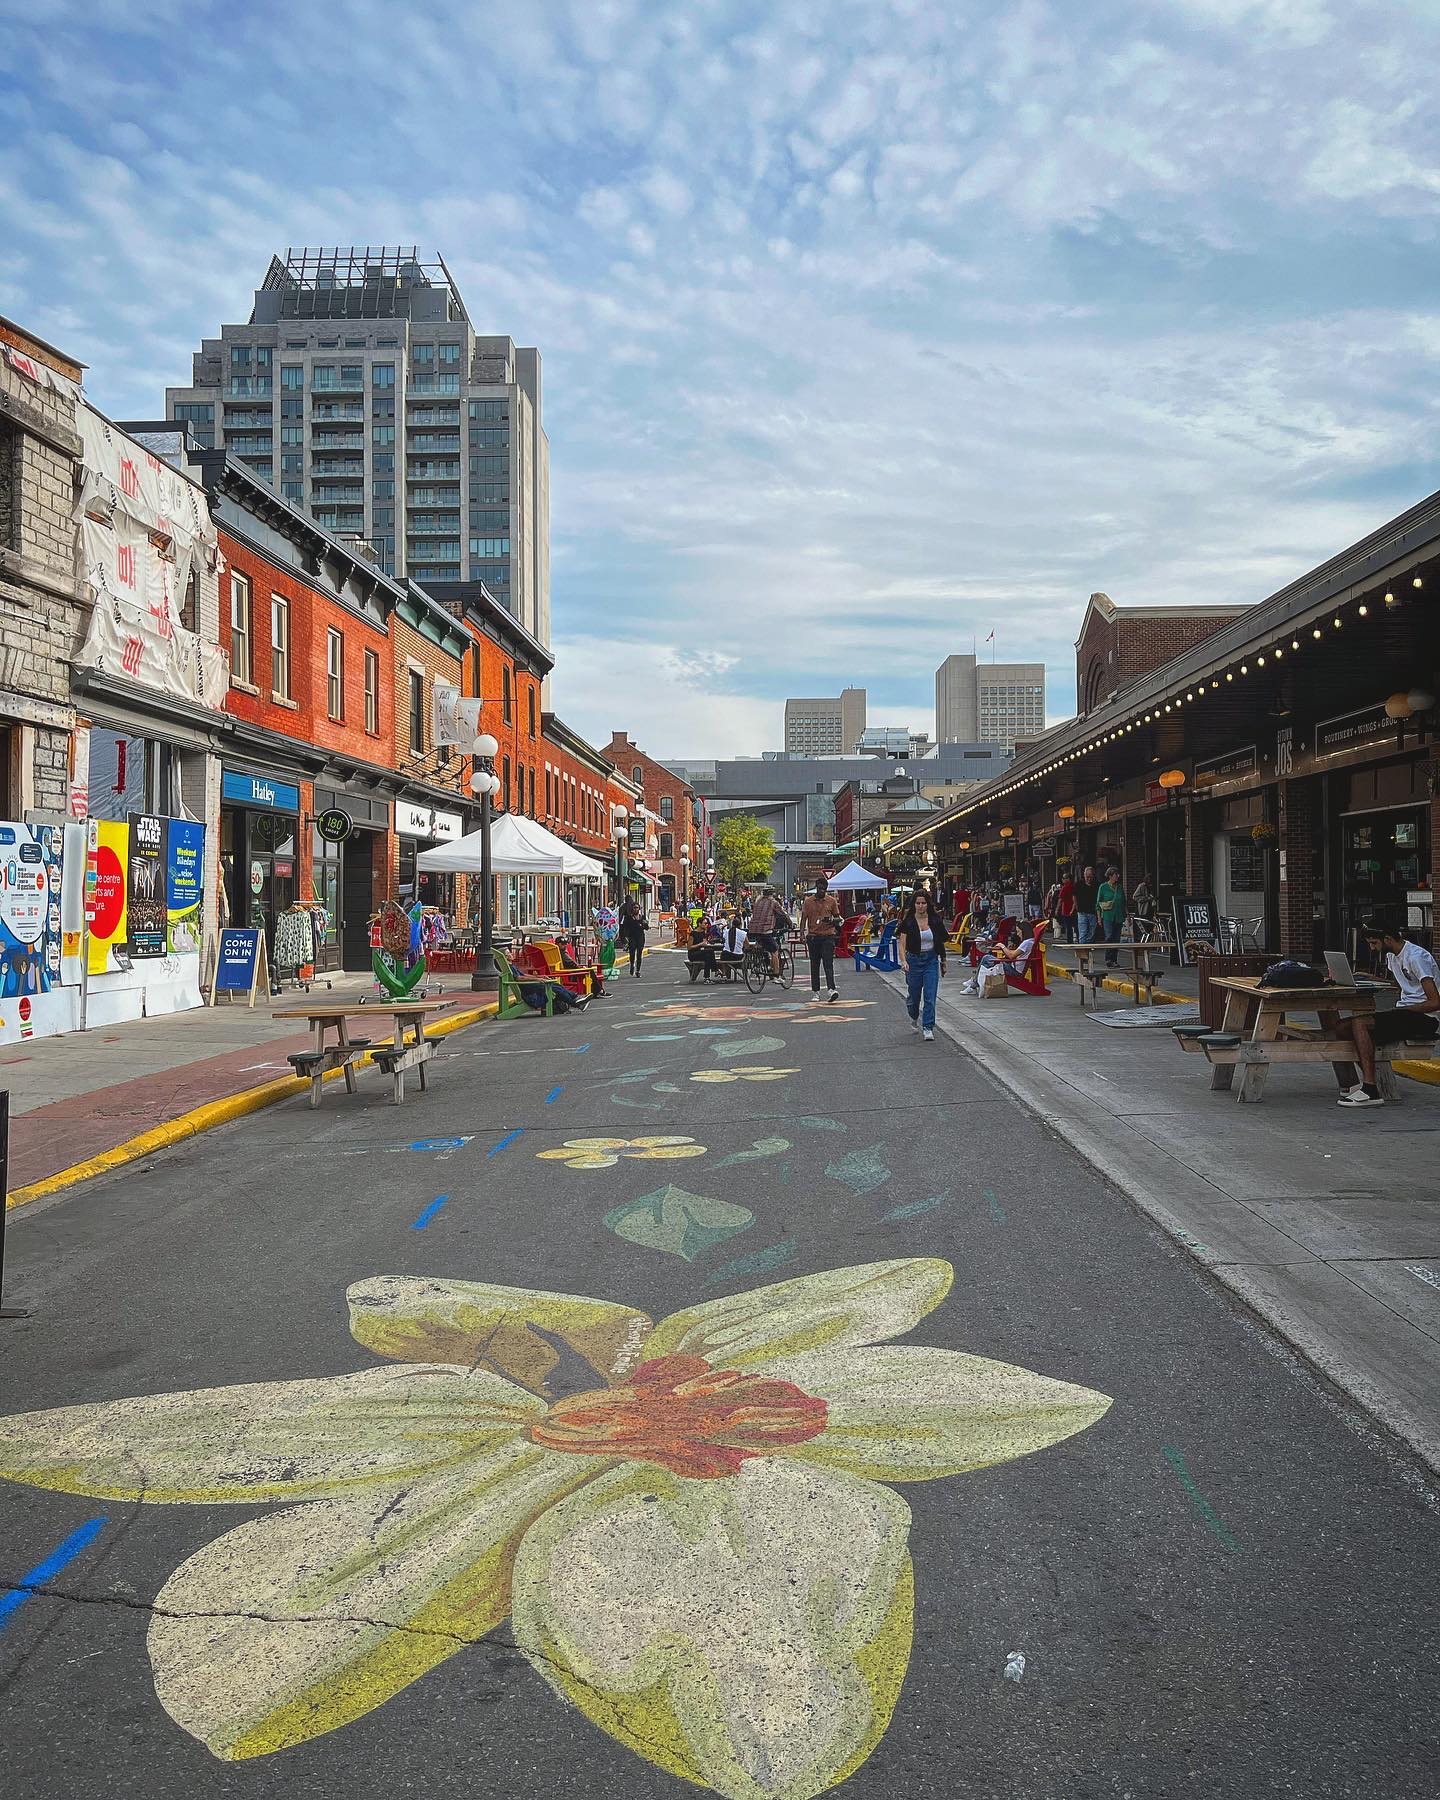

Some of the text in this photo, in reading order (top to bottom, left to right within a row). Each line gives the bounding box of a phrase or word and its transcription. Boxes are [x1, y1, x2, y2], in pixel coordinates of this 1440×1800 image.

[1275, 741, 1293, 776] JOS
[251, 780, 275, 806] Hatley
[137, 817, 161, 831] STAR
[137, 828, 161, 843] WARS
[103, 874, 120, 884] centre
[104, 887, 114, 896] and
[1188, 911, 1208, 924] JOS
